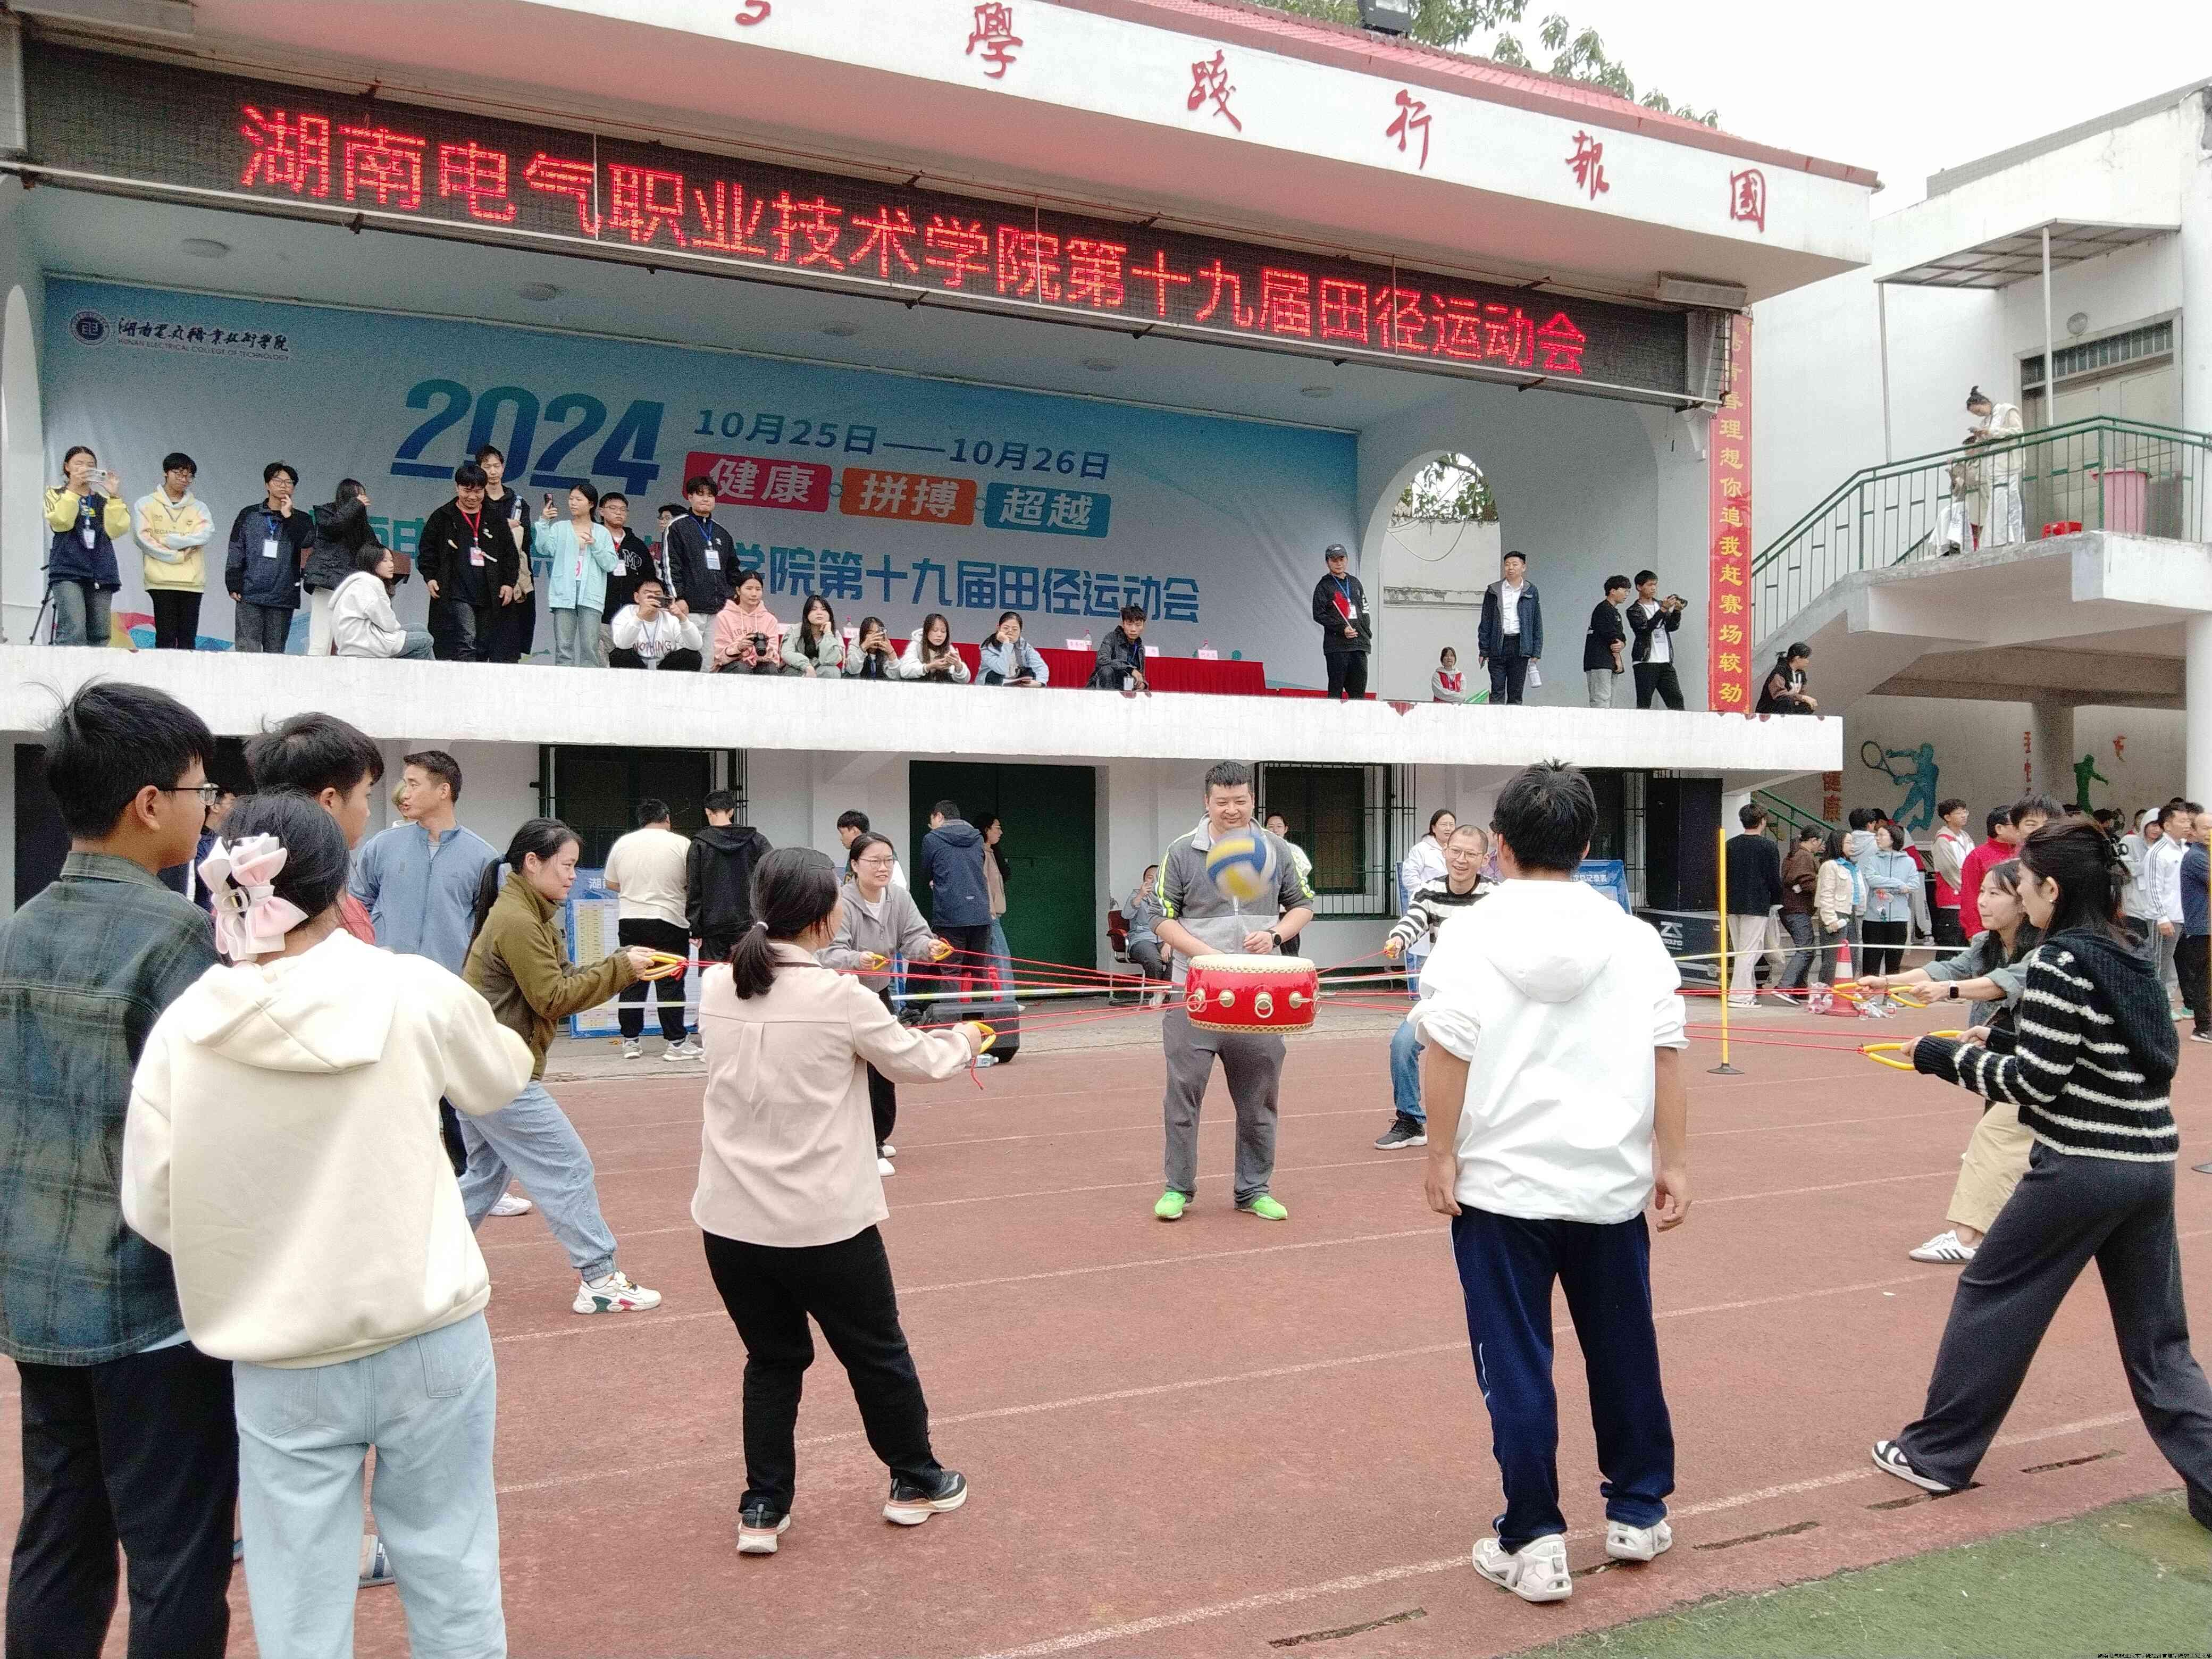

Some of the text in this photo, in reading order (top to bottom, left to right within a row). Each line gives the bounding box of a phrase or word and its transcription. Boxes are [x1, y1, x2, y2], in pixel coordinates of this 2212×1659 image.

[241, 106, 1586, 375] 湖南电气职业技术学院第十九届田径运动会
[146, 342, 189, 351] ELECTRICAL
[191, 346, 224, 355] COLLEGE
[390, 379, 665, 496] 2024
[708, 458, 1094, 530] 健康 拼搏 超越
